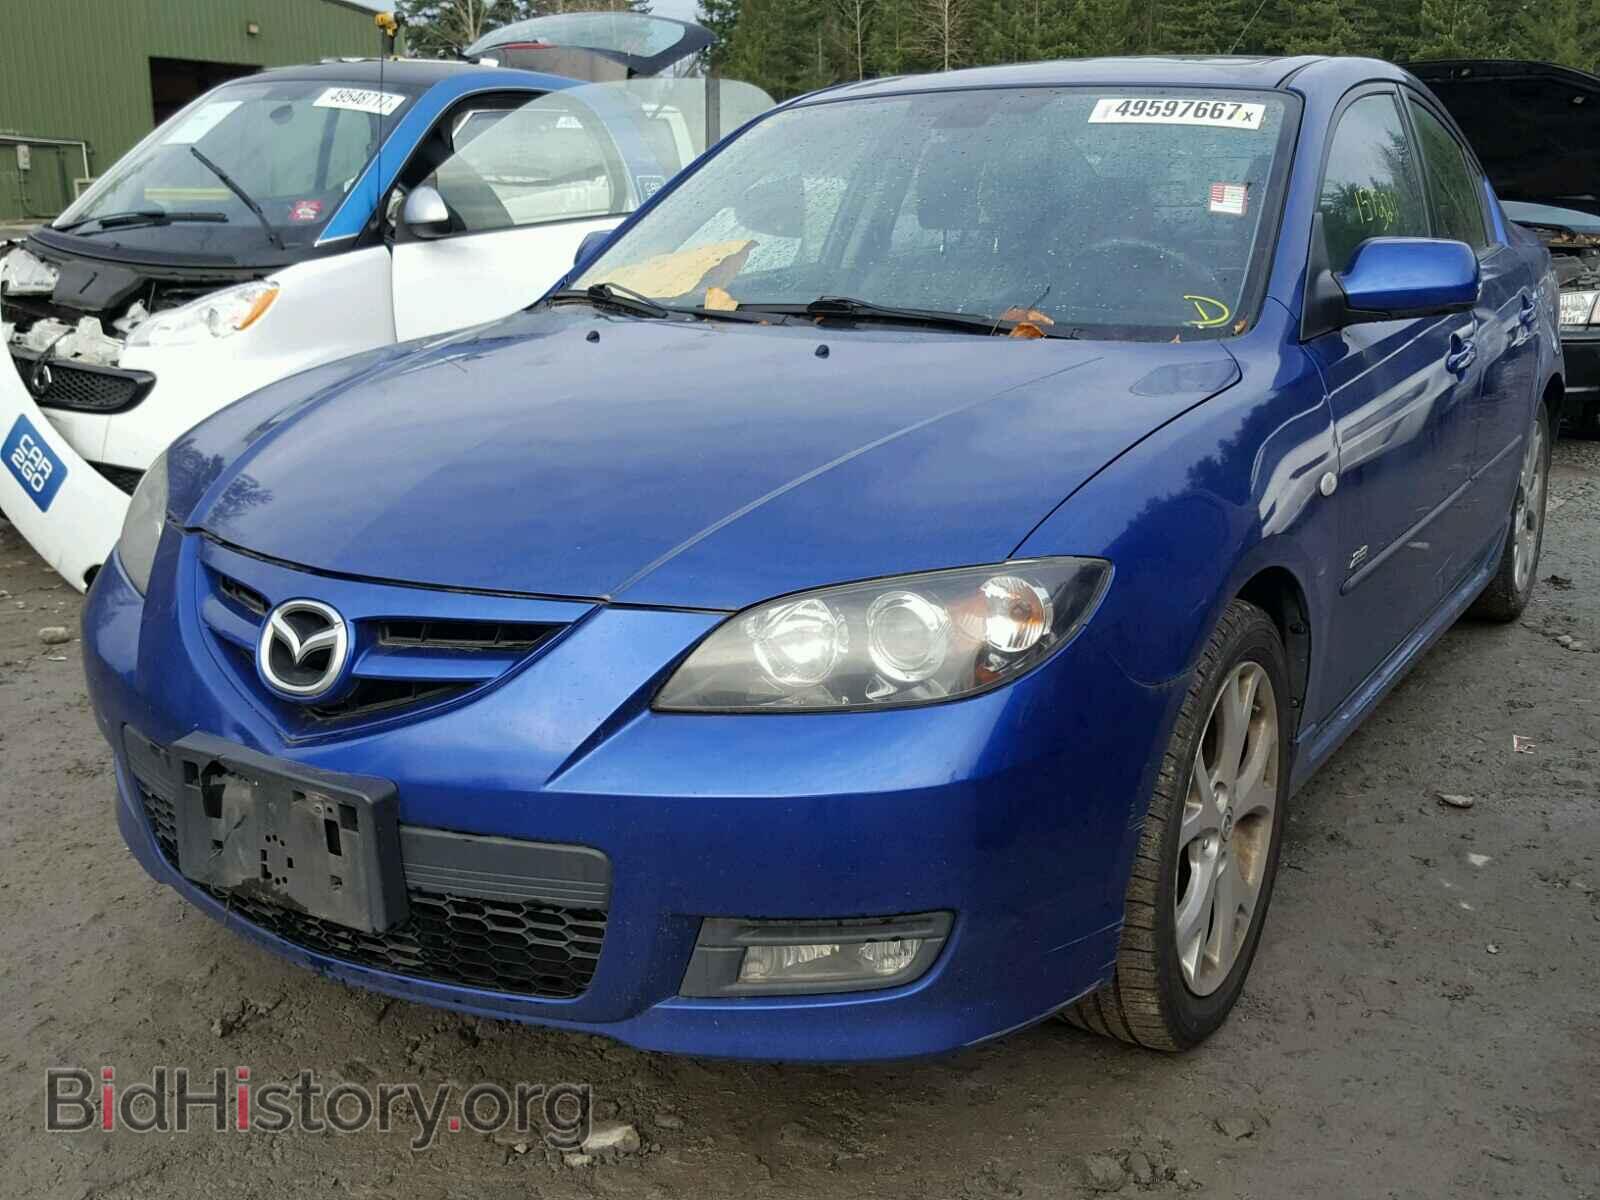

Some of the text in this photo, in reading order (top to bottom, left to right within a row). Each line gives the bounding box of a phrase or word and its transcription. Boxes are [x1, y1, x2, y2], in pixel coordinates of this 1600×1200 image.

[1115, 100, 1242, 121] 49597667
[1183, 295, 1230, 326] D
[11, 448, 45, 492] 2GO
[19, 434, 53, 480] CAR
